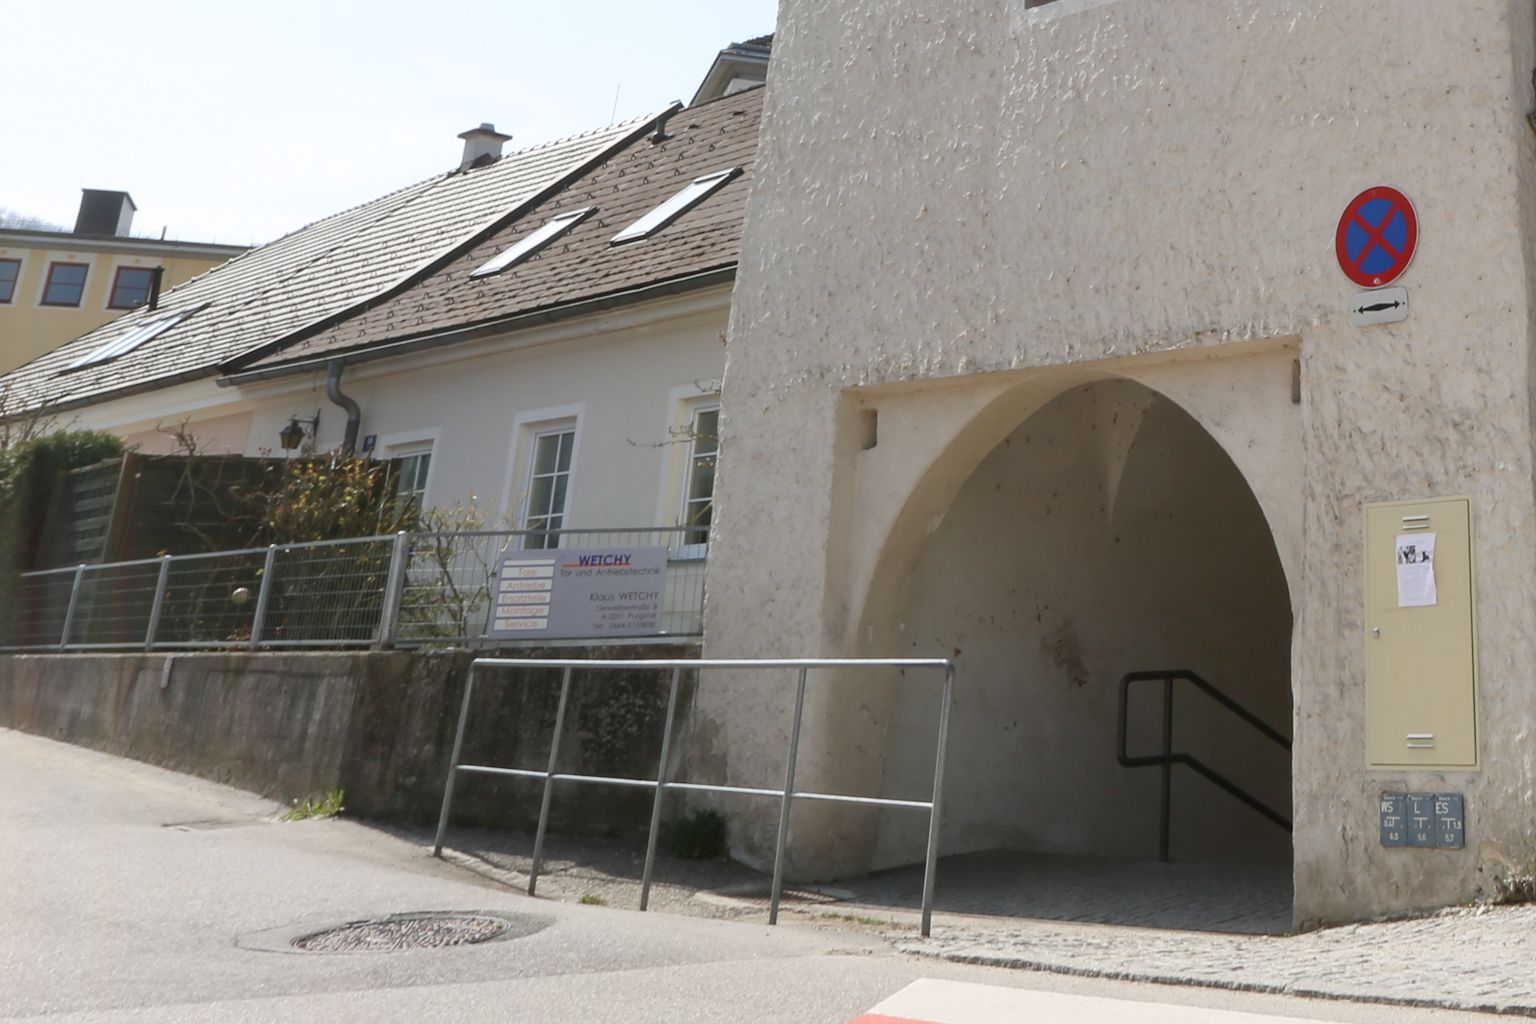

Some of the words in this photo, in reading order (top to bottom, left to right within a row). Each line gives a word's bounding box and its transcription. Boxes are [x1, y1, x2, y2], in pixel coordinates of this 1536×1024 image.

[579, 554, 632, 566] WETCHY
[560, 569, 572, 577] Tor
[576, 568, 592, 577] und
[595, 566, 660, 576] Antriebstechnik
[507, 580, 545, 589] Antriebe
[590, 591, 615, 601] Klaus
[619, 590, 660, 600] WETCHY
[501, 605, 544, 616] Montage
[1381, 802, 1394, 813] WS
[1414, 802, 1421, 813] L
[1436, 802, 1448, 814] ES
